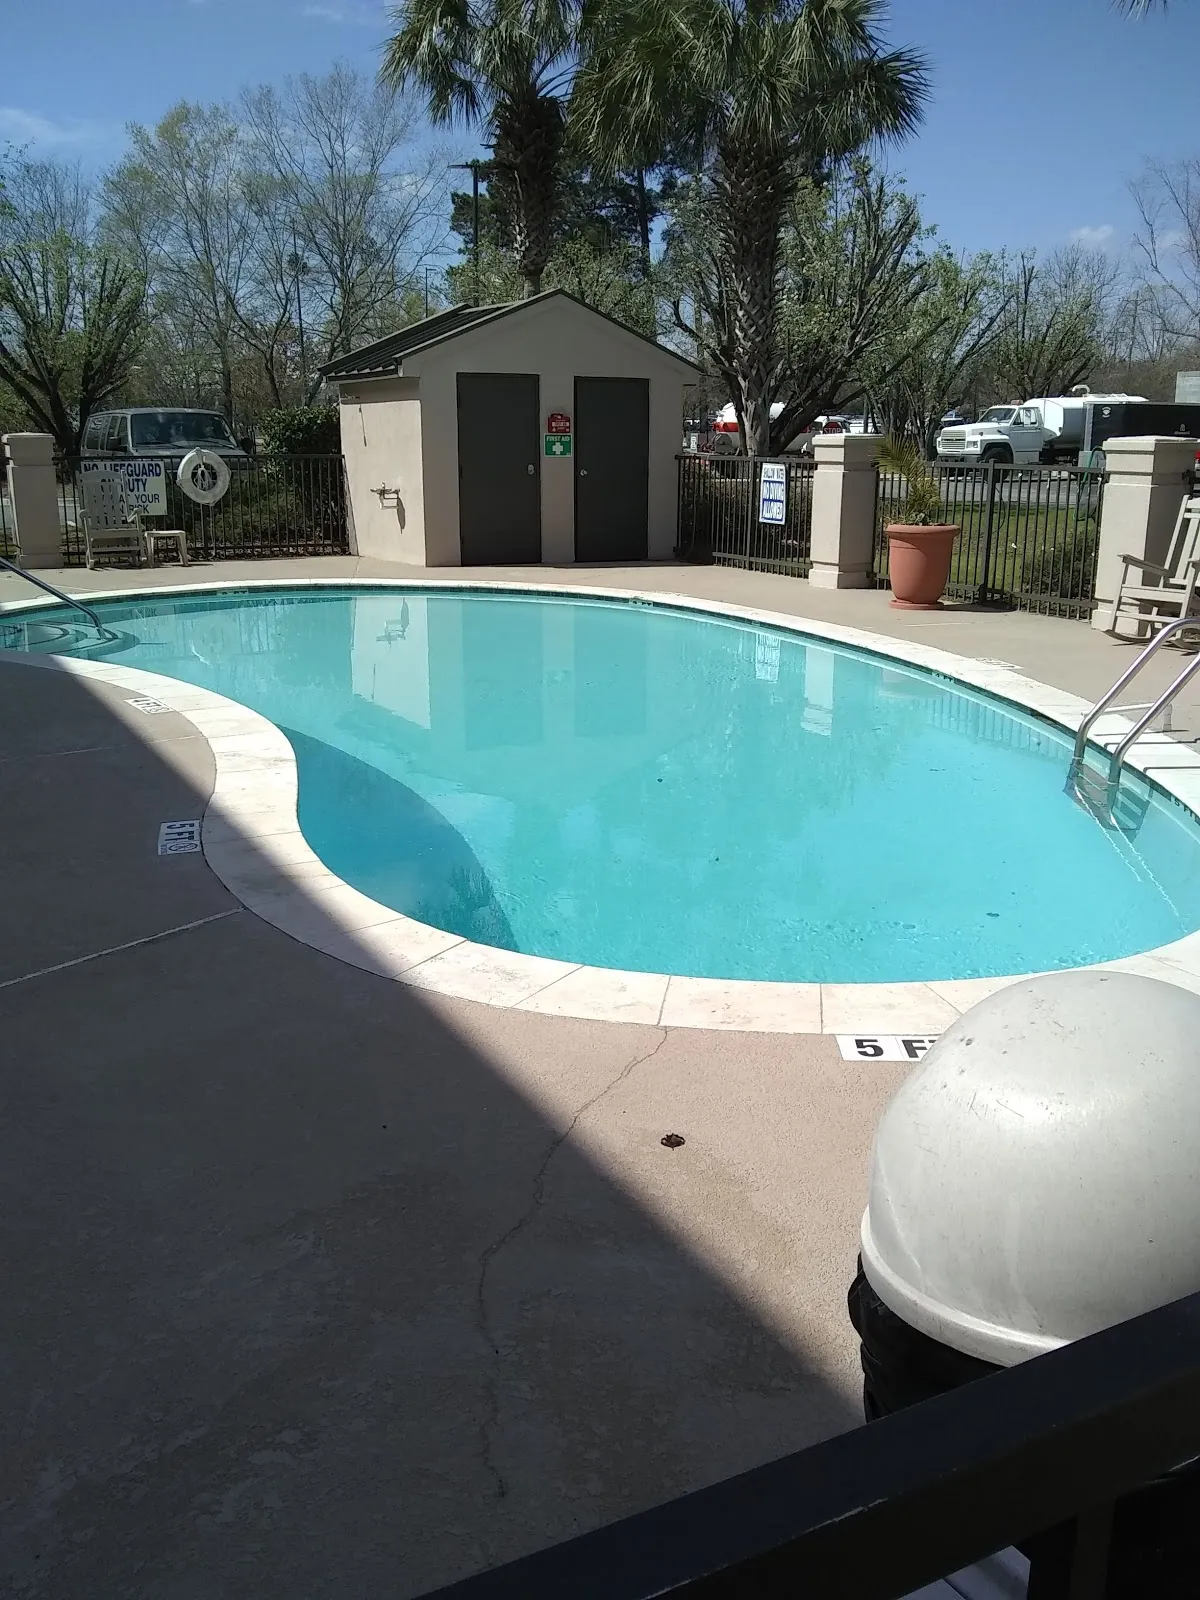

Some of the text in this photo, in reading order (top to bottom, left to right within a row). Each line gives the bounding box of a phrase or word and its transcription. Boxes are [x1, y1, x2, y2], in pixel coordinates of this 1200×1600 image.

[134, 493, 160, 504] YOUR
[167, 822, 195, 830] 5
[854, 1039, 884, 1058] 5
